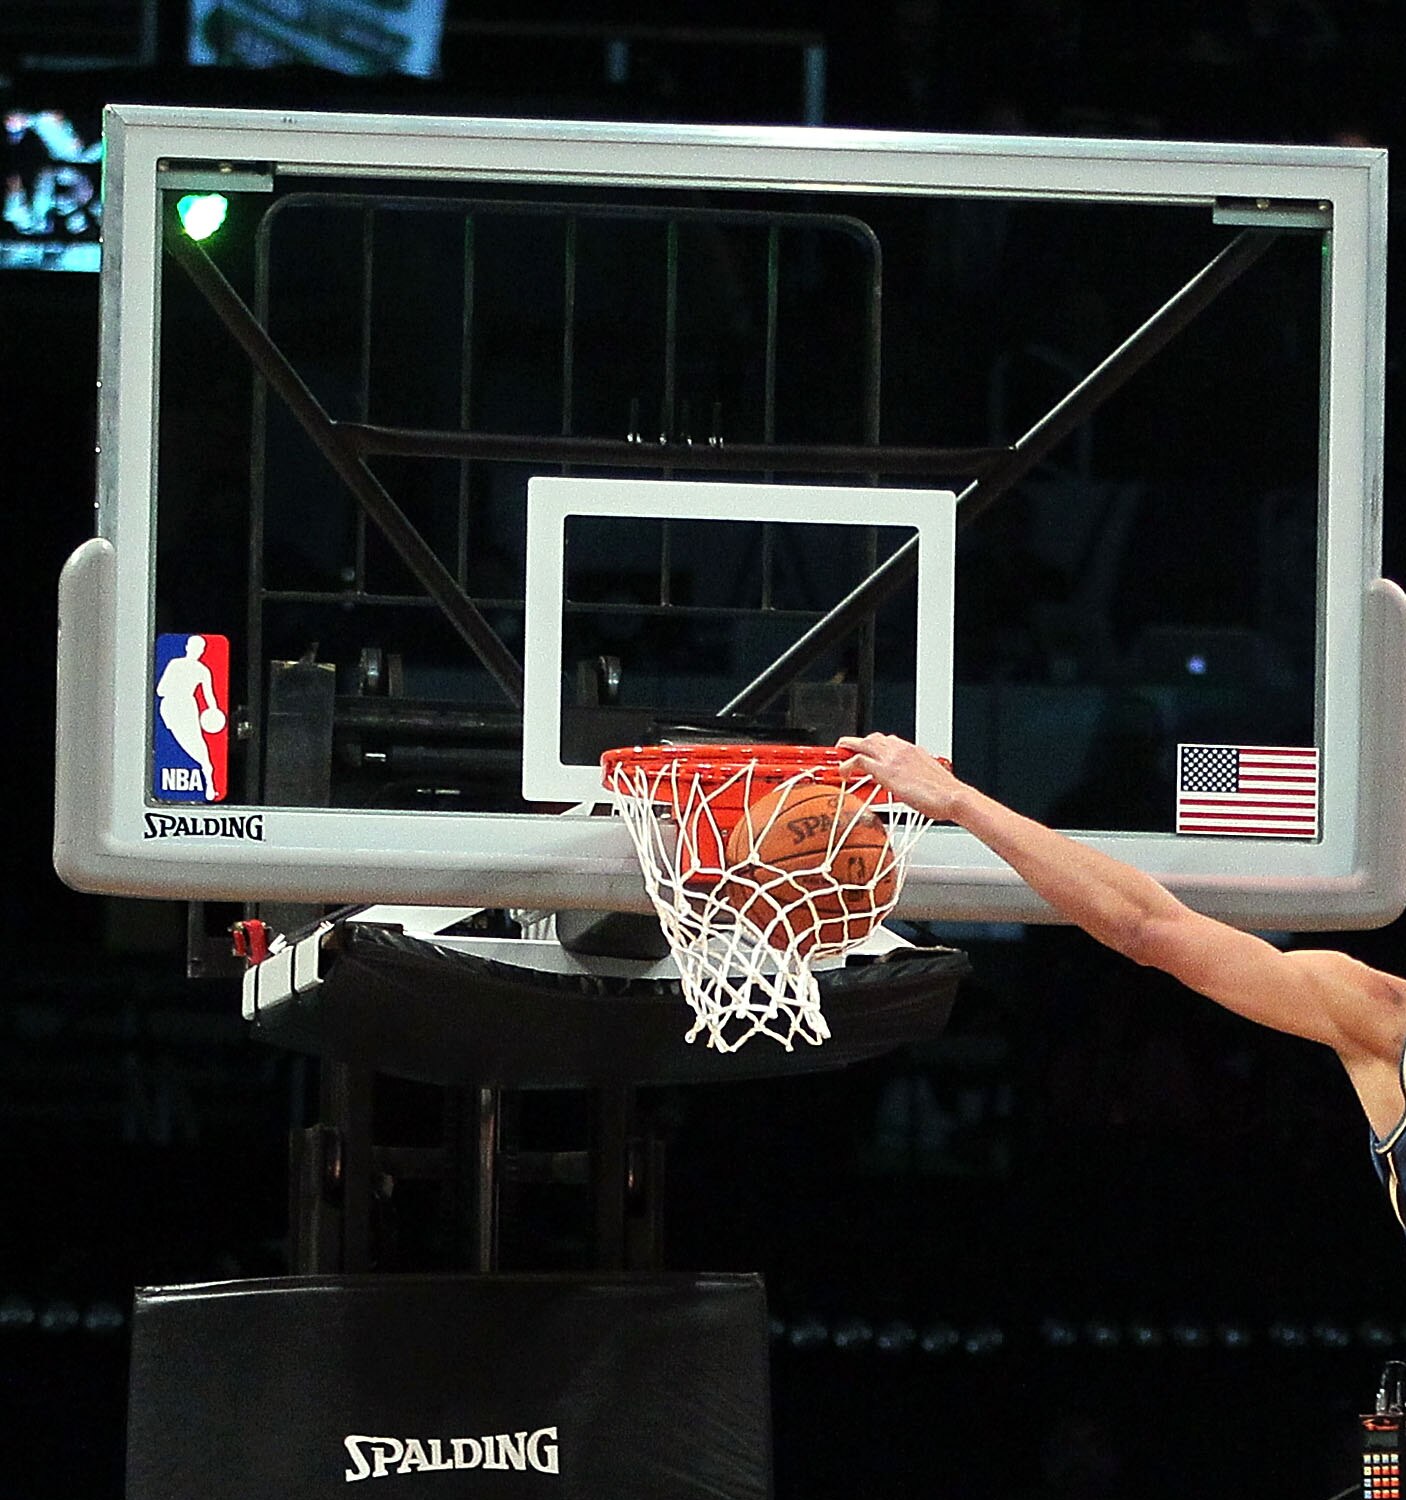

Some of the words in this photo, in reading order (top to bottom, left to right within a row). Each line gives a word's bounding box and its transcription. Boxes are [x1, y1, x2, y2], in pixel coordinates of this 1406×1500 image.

[161, 768, 204, 791] NBA
[144, 812, 263, 841] SPALDING
[344, 1426, 560, 1482] SPALDING
